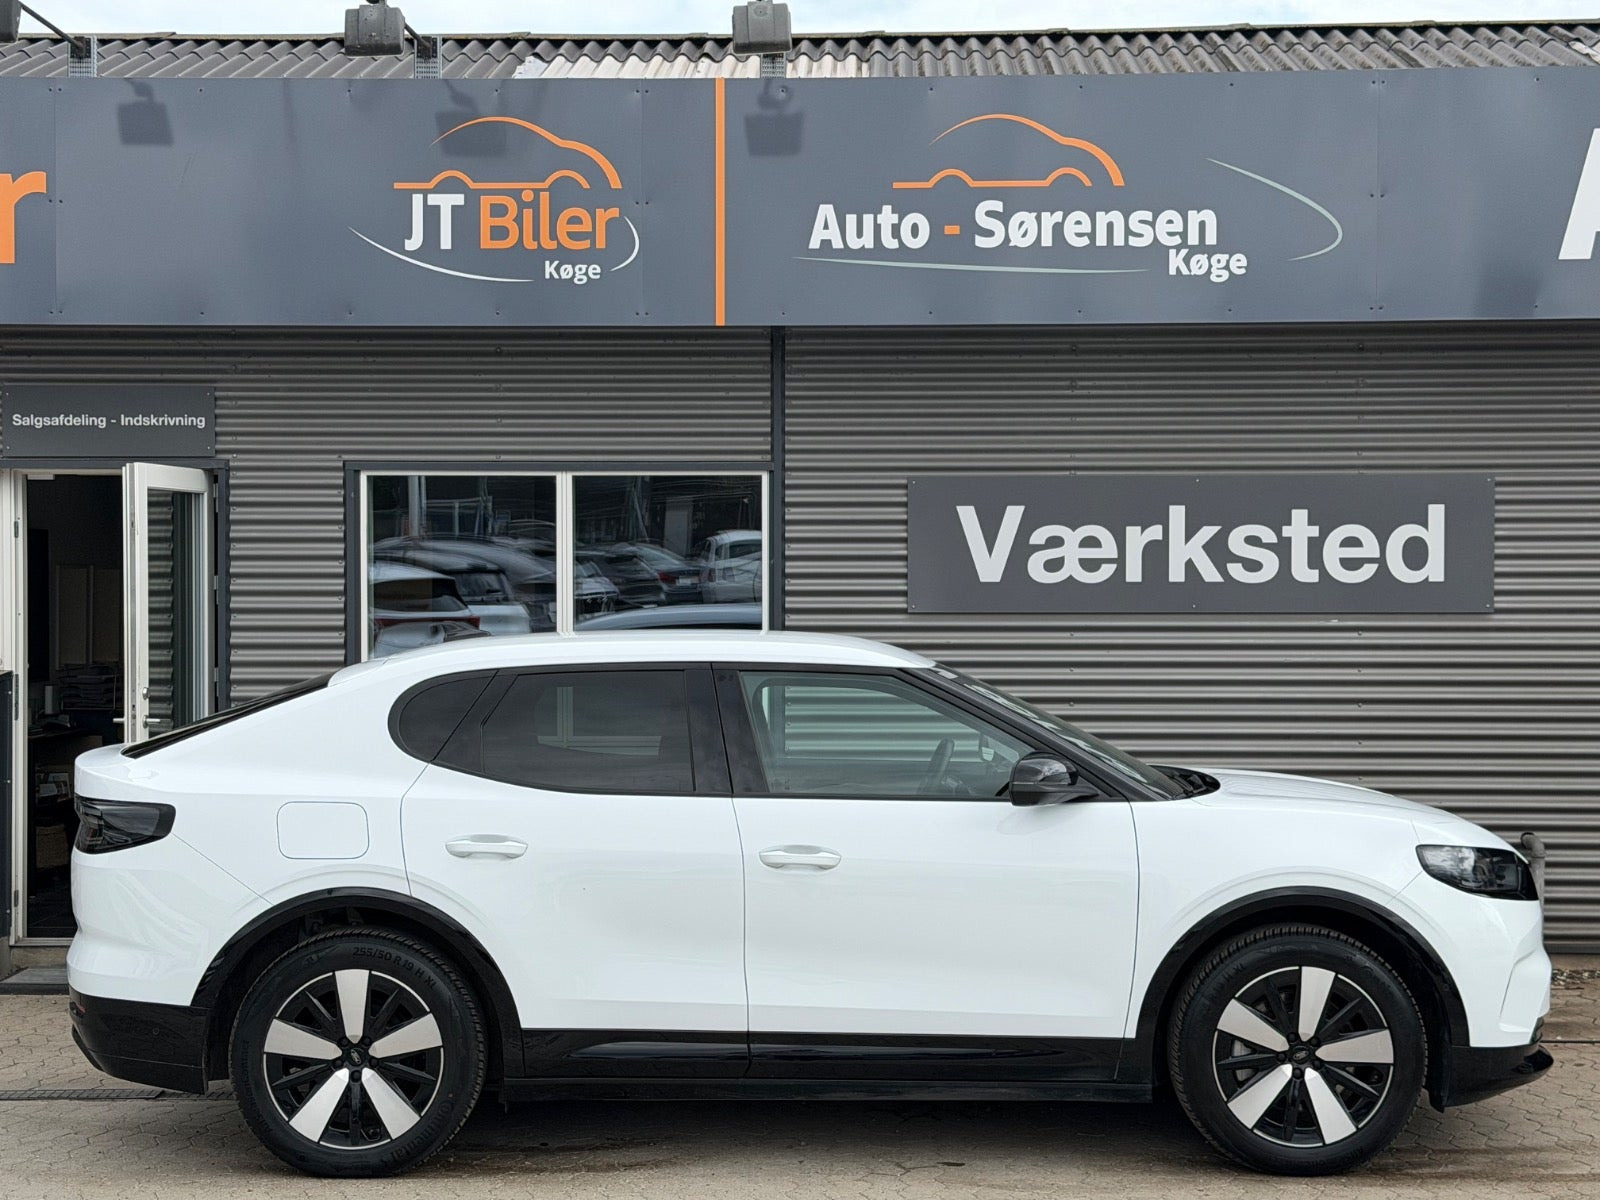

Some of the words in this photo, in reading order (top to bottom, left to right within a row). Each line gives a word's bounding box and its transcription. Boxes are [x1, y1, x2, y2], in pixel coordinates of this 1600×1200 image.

[0, 171, 47, 264] r
[404, 193, 465, 251] JT
[479, 191, 620, 251] Biler
[808, 203, 931, 250] Auto
[974, 199, 1218, 249] Sørensen
[543, 260, 602, 285] Køge
[1167, 248, 1248, 283] Køge
[12, 413, 107, 429] Salgsafdeling
[120, 413, 206, 429] Indskrivning
[956, 503, 1446, 584] Værksted
[353, 947, 392, 961] 255/50
[393, 955, 403, 966] R
[402, 960, 415, 971] 19
[414, 967, 425, 978] H
